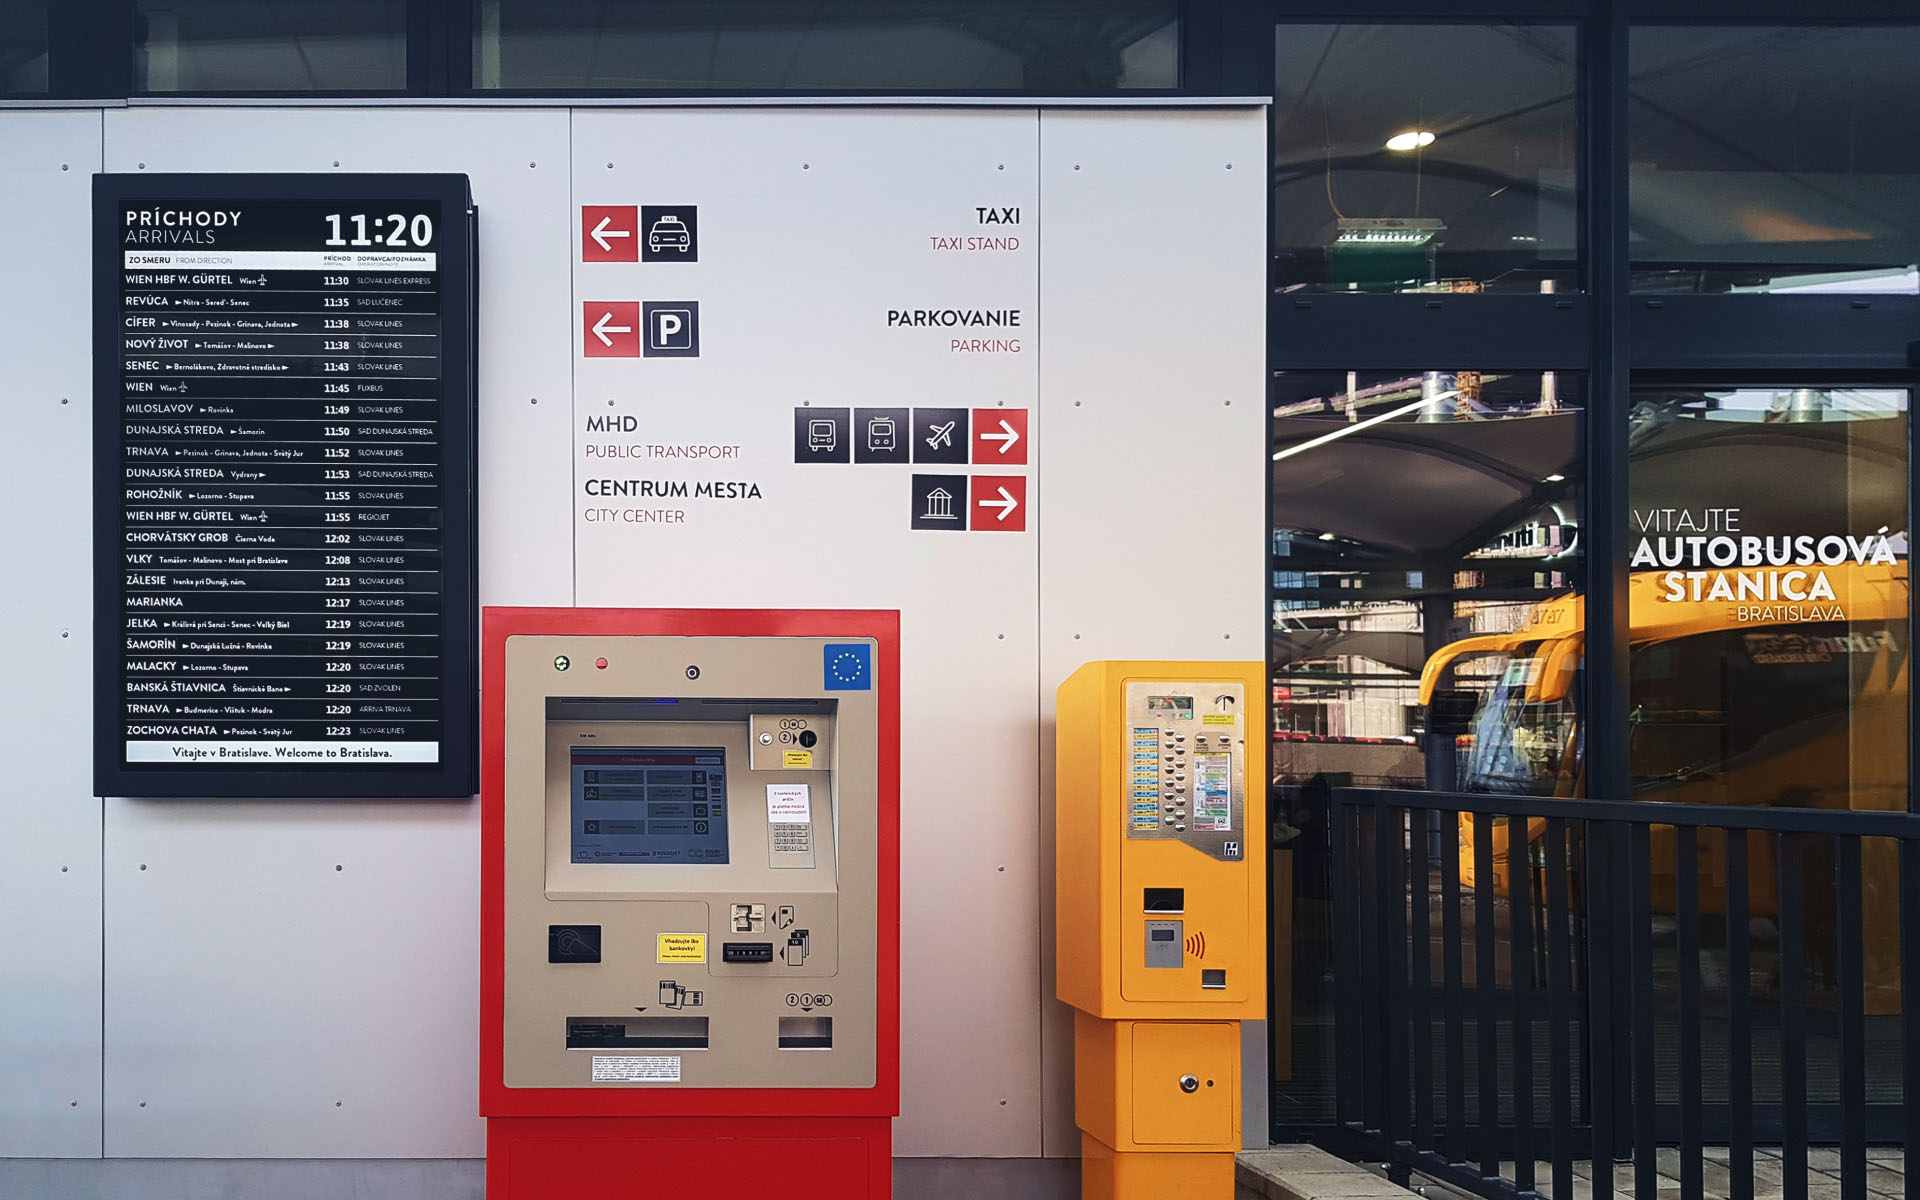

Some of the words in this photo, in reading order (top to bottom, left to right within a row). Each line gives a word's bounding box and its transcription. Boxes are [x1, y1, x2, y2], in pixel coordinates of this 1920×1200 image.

[126, 207, 242, 227] PRÍCHODY
[976, 207, 1021, 225] TAXI
[325, 214, 433, 246] 11:20
[125, 230, 215, 245] ARRIVALS
[930, 237, 962, 251] TAXI
[967, 237, 1020, 251] STAND
[196, 257, 233, 265] DIRECTION
[125, 275, 154, 284] WIEN
[154, 275, 177, 284] HBF
[178, 275, 191, 284] W.
[192, 273, 233, 285] GÜRTEL
[323, 277, 350, 286] 11:30
[125, 295, 169, 306] REVÚCA
[323, 298, 350, 307] 11:35
[125, 316, 156, 327] CÍFER
[887, 310, 1021, 327] PARKOVANIE
[323, 320, 350, 329] 11:38
[660, 315, 682, 345] P
[125, 338, 157, 349] NOVÝ
[157, 338, 189, 349] ŽIVOT
[323, 341, 350, 350] 11:38
[951, 340, 1021, 353] PARKING
[125, 361, 160, 371] SENEC
[323, 363, 350, 372] 11:43
[125, 383, 154, 392] WIEN
[324, 384, 350, 393] 11:45
[125, 404, 194, 413] MILOSLAVOV
[324, 406, 350, 415] 11:49
[586, 416, 638, 432] MHD
[125, 424, 182, 435] DUNAJSKÁ
[183, 426, 225, 435] STREDA
[324, 427, 350, 436] 11:50
[125, 447, 169, 456] TRNAVA
[324, 449, 350, 458] 11:52
[585, 445, 643, 459] PUBLIC
[646, 445, 740, 459] TRANSPORT
[125, 467, 183, 478] DUNAJSKÁ
[183, 469, 225, 478] STREDA
[324, 470, 351, 479] 11:53
[125, 488, 183, 499] ROHOŽNÍK
[585, 479, 689, 498] CENTRUM
[695, 481, 762, 500] MESTA
[324, 492, 351, 501] 11:55
[125, 512, 154, 521] WIEN
[155, 512, 178, 521] HBF
[179, 512, 192, 521] W.
[192, 510, 234, 521] GÜRTEL
[324, 513, 351, 522] 11:55
[584, 509, 619, 523] CITY
[623, 509, 685, 524] CENTER
[1634, 508, 1740, 532] VITAJTE
[125, 531, 197, 542] CHORVÁTSKY
[197, 533, 229, 543] GROB
[324, 535, 351, 544] 12:02
[1631, 526, 1897, 567] AUTOBUSOVÁ
[125, 555, 154, 564] VLKY
[324, 556, 351, 565] 12:08
[125, 574, 167, 585] ZÁLESIE
[324, 578, 351, 587] 12:13
[1665, 570, 1836, 601] STANICA
[125, 597, 184, 607] MARIANKA
[324, 599, 351, 608] 12:17
[1737, 605, 1846, 621] BRATISLAVA
[125, 619, 158, 628] JELKA
[324, 620, 351, 629] 12:19
[125, 638, 176, 649] ŠAMORÍN
[324, 642, 351, 651] 12:19
[125, 662, 177, 671] MALACKY
[325, 663, 351, 672] 12:20
[126, 681, 169, 692] BANSKÁ
[170, 681, 227, 693] ŠTIAVNICA
[325, 685, 351, 693] 12:20
[126, 704, 170, 714] TRNAVA
[325, 706, 351, 715] 12:20
[126, 726, 180, 735] ZOCHOVA
[180, 726, 218, 735] CHATA
[325, 727, 351, 736] 12:23
[172, 746, 208, 761] Vitajte
[219, 746, 272, 758] Bratislave.
[275, 746, 323, 758] Welcome
[326, 748, 337, 758] to
[340, 747, 393, 759] Bratislava.
